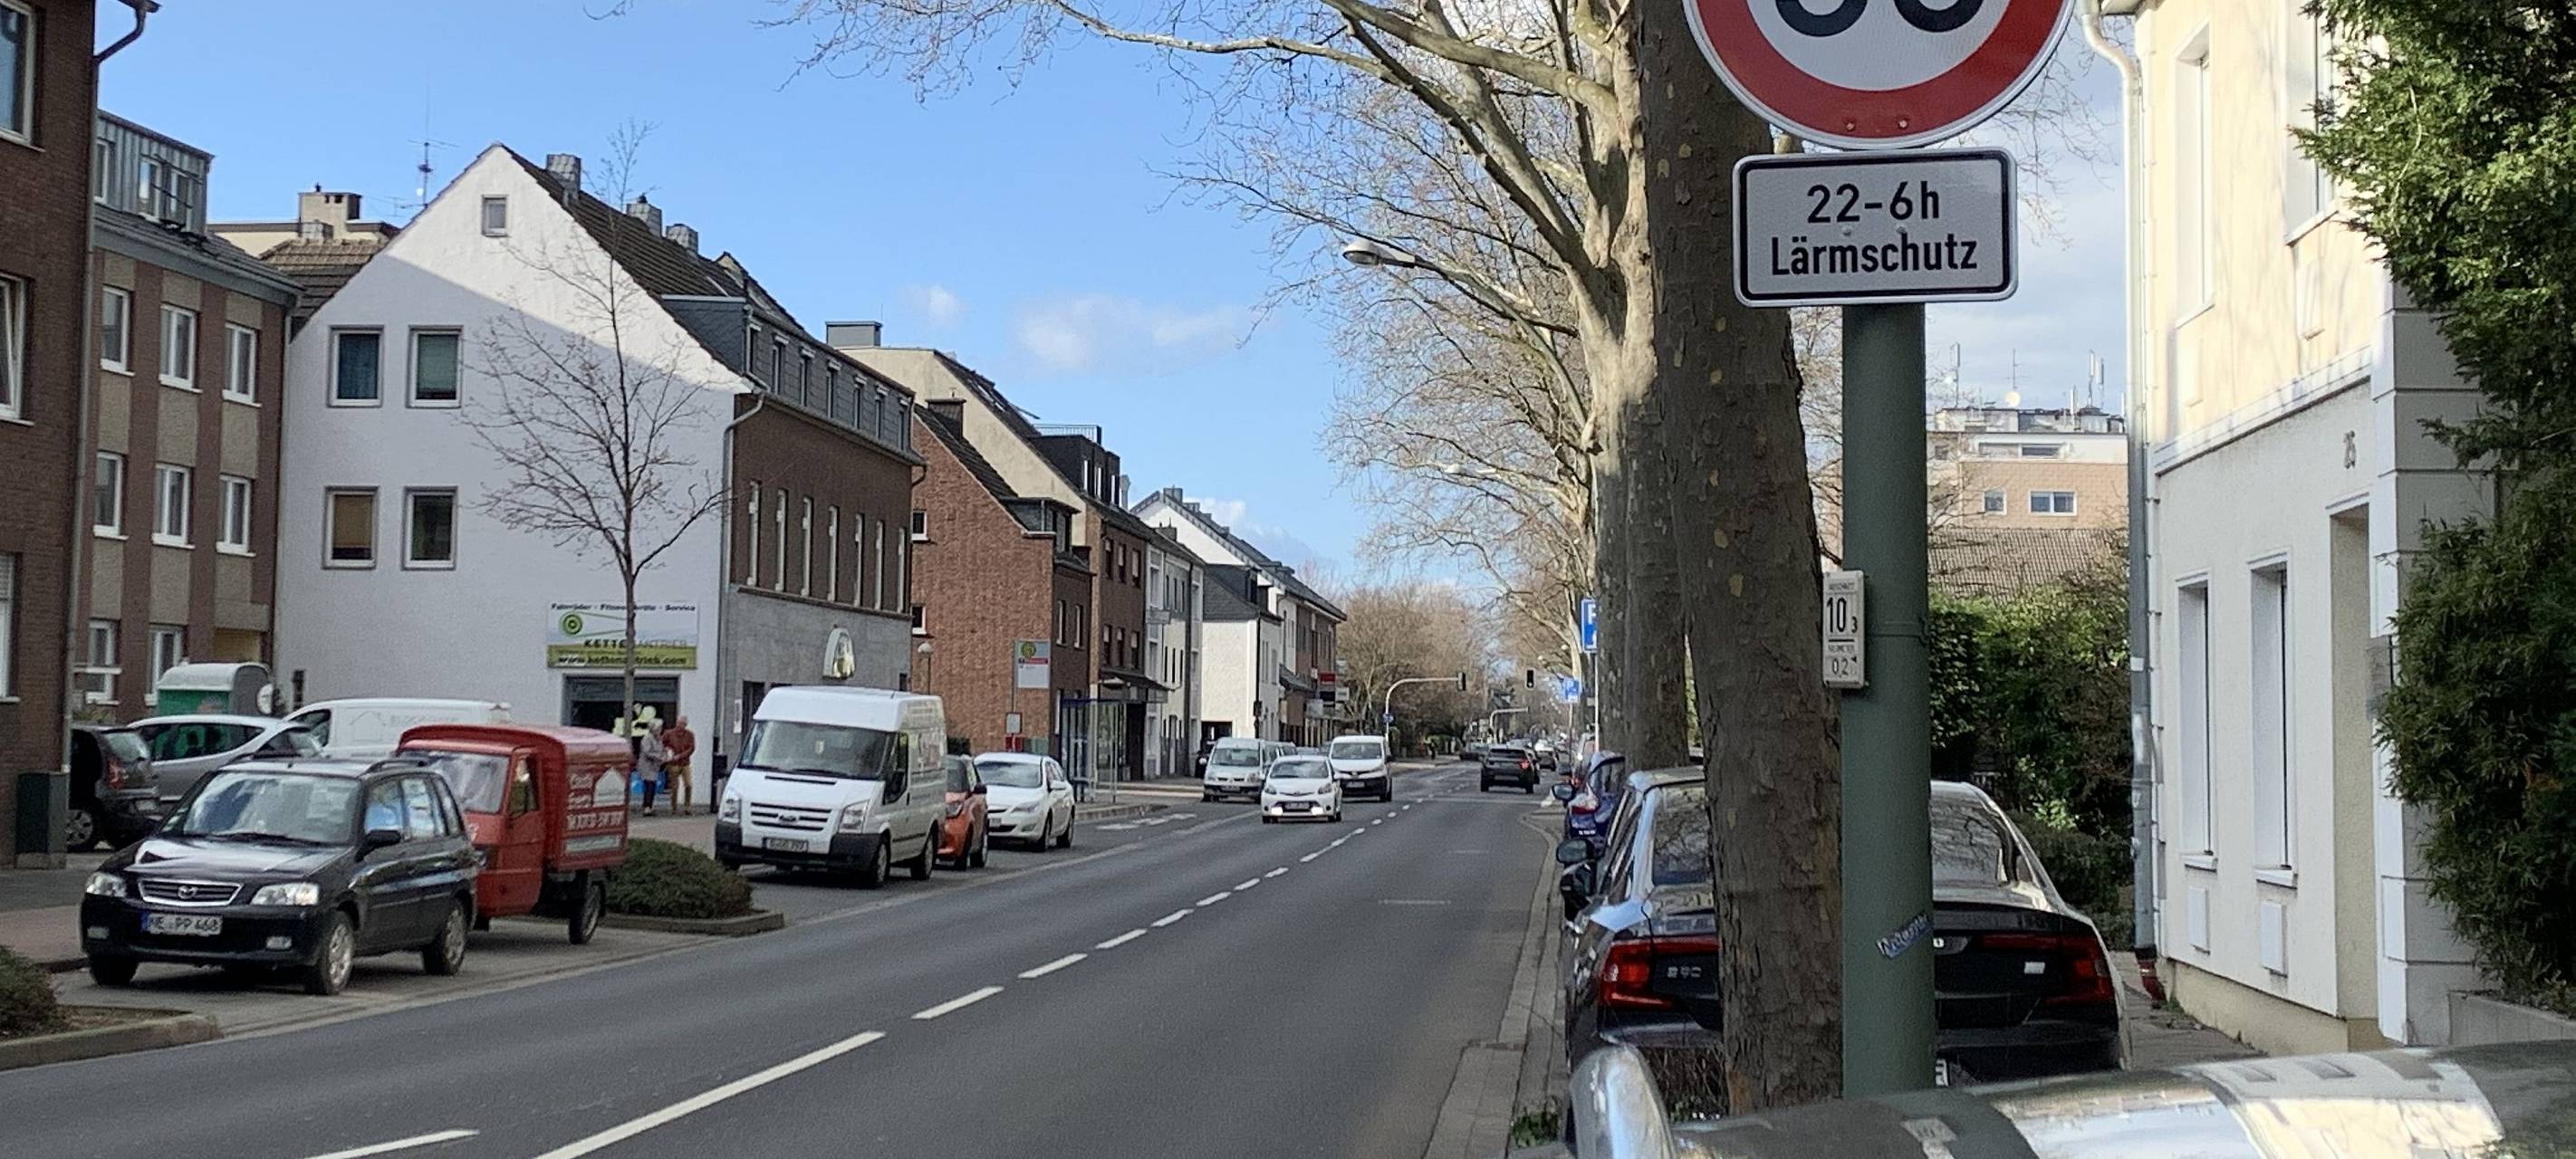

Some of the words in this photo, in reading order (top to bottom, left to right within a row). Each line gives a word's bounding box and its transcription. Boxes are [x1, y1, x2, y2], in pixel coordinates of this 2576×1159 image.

[1772, 232, 1978, 275] Lärmschutz
[1826, 597, 1847, 633] 10
[1851, 616, 1858, 633] 3
